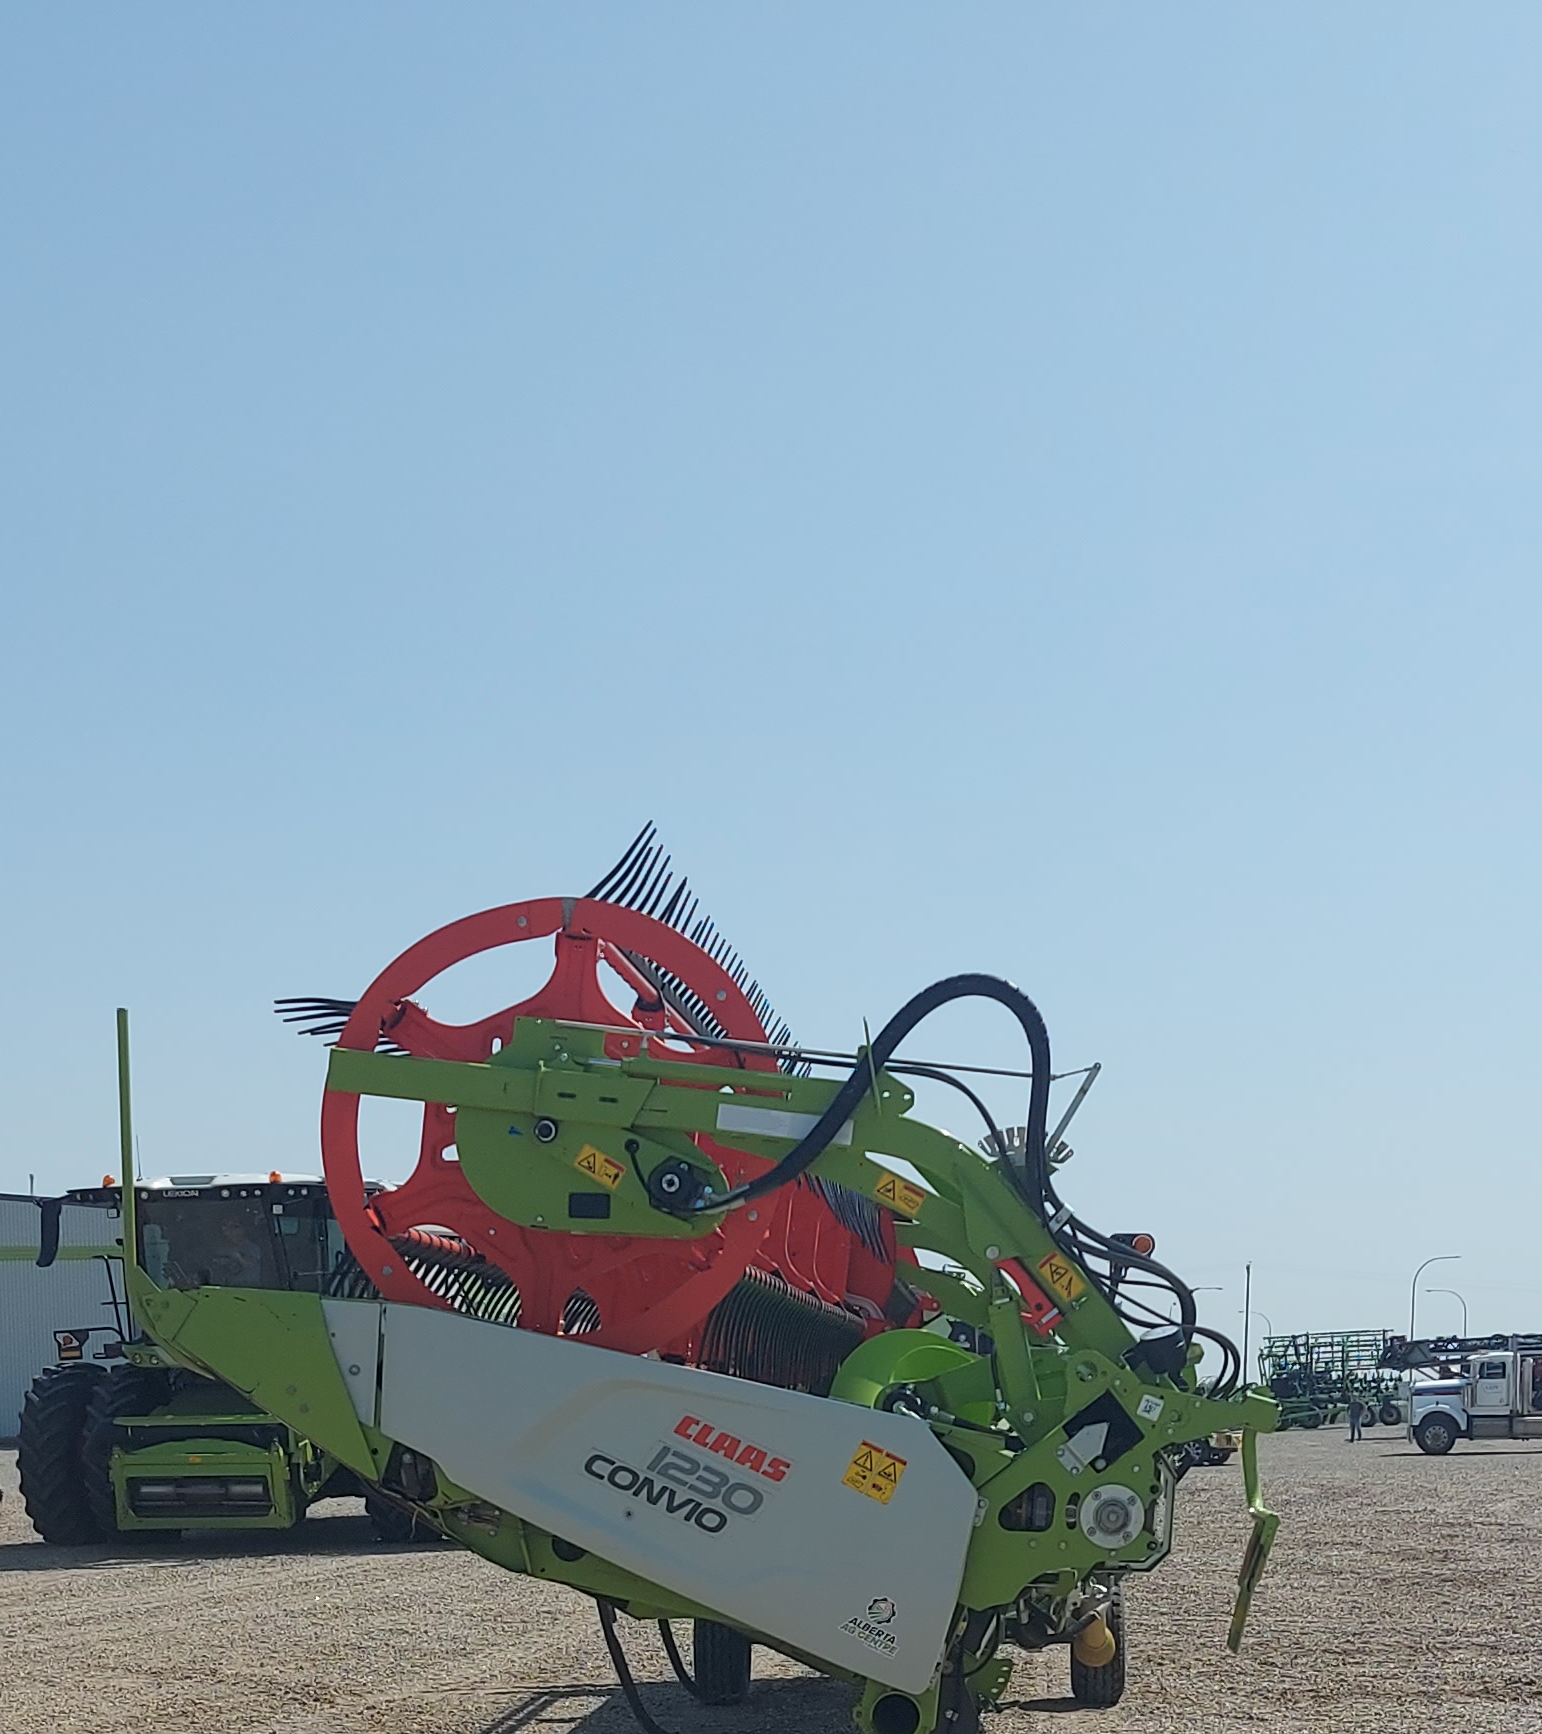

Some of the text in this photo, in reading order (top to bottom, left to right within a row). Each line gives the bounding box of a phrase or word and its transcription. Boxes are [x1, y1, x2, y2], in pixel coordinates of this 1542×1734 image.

[646, 1445, 764, 1515] 1230
[673, 1414, 791, 1483] CLAAS
[584, 1454, 728, 1533] CONVIO
[848, 1617, 896, 1645] ALBERTA
[857, 1631, 899, 1655] CENTRE
